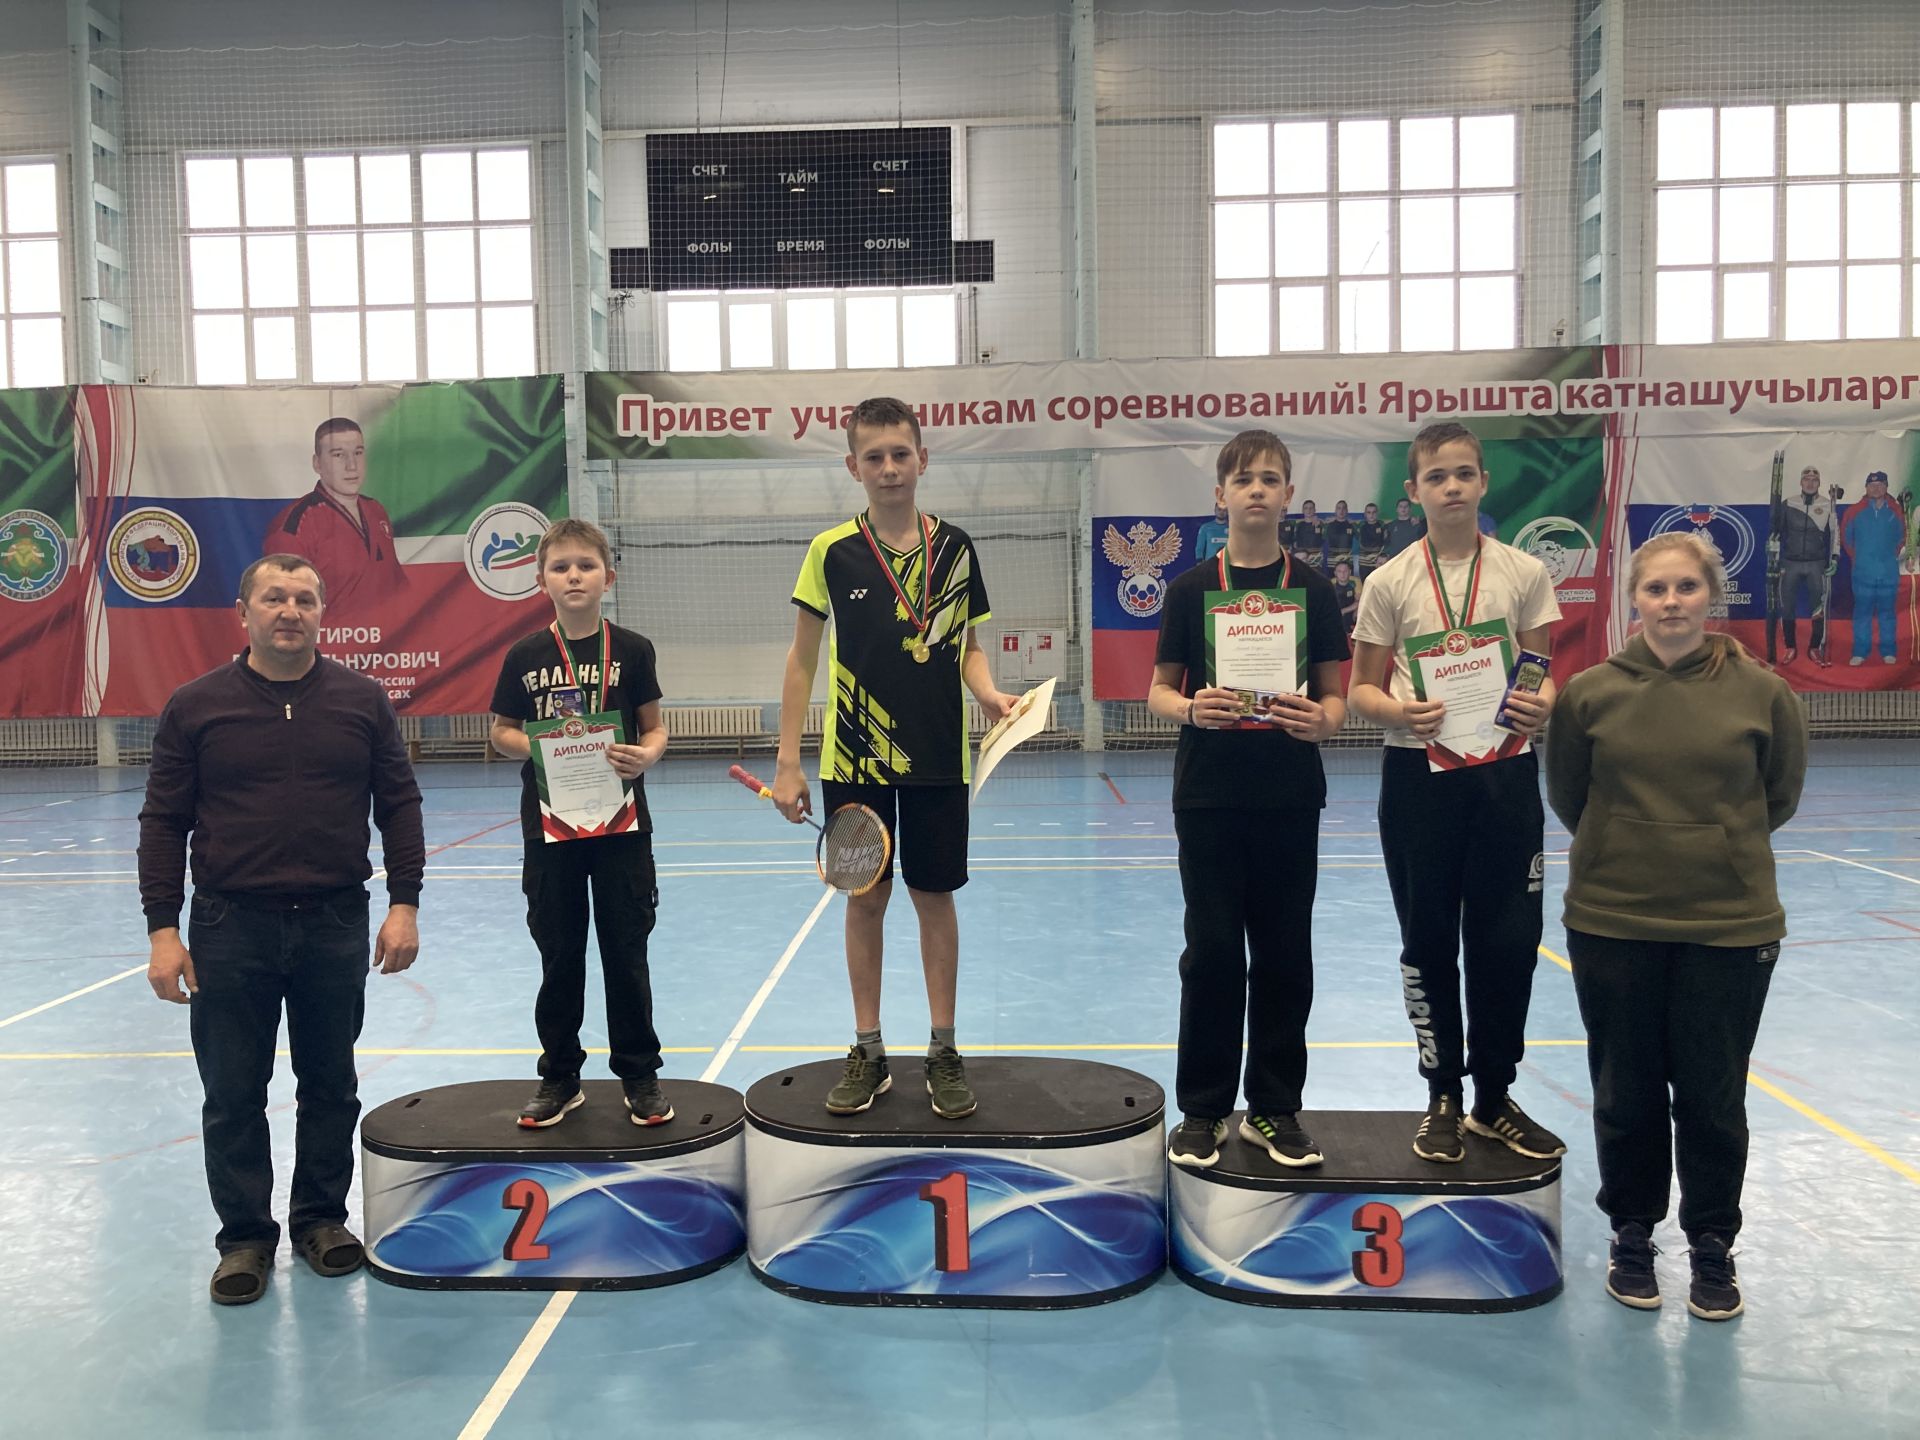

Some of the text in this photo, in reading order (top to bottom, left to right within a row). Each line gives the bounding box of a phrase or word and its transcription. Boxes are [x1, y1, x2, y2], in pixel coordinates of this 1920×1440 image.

[692, 165, 728, 176] СЧЕТ
[872, 160, 909, 172] СЧЕТ
[778, 169, 819, 184] ТАЙМ
[687, 241, 732, 253] ФОЛЫ
[777, 240, 825, 252] ВРЕМЯ
[864, 238, 910, 250] ФОЛЫ
[621, 374, 1920, 441] Привет учаникам соревнований! Ярышта катнашучыларг
[315, 627, 381, 644] ГИРОВ
[1227, 624, 1284, 637] ДИПЛОМ
[1435, 657, 1492, 680] ДИПЛОМ
[553, 742, 605, 758] ДИПЛОМ
[502, 1178, 550, 1261] 2
[918, 1171, 970, 1272] 1
[1351, 1202, 1404, 1288] 3
